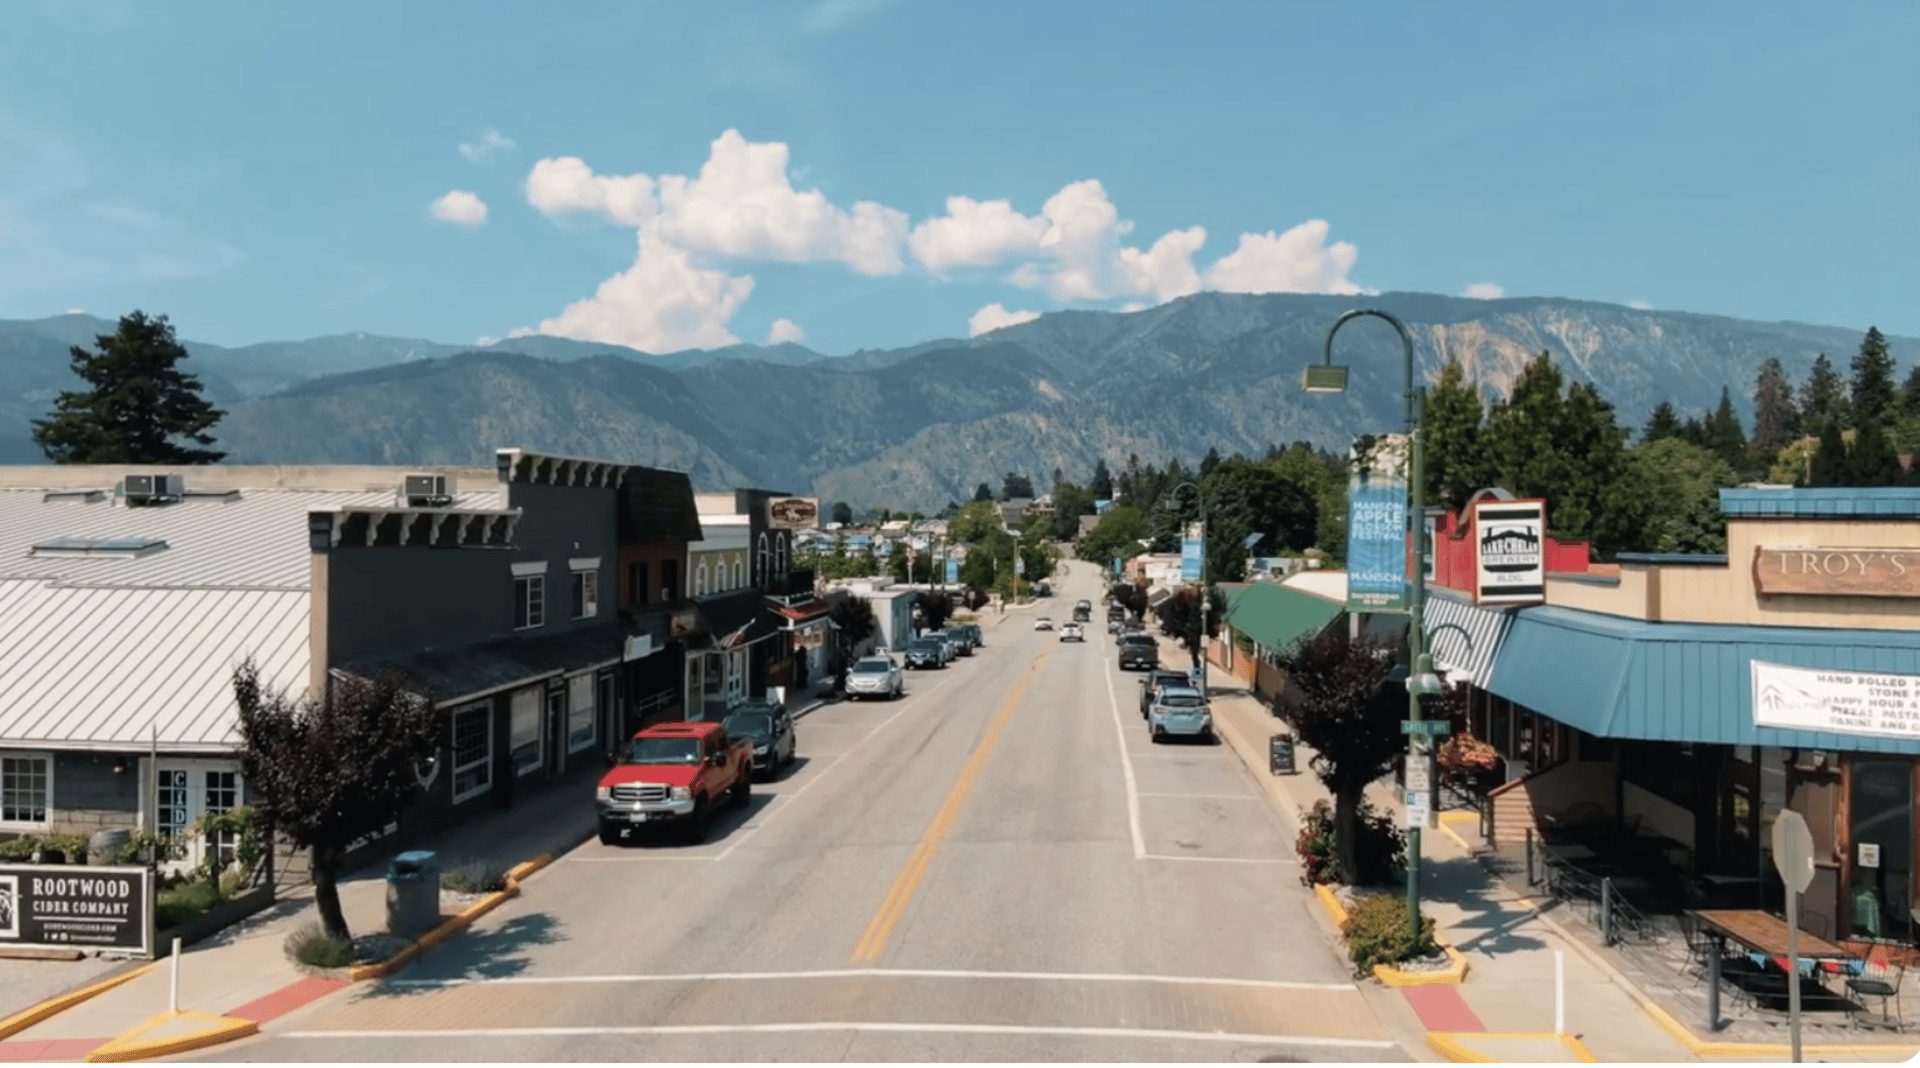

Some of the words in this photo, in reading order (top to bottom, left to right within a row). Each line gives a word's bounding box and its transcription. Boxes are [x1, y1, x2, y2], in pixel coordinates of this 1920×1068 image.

[1353, 501, 1402, 510] MANSON
[1353, 510, 1402, 523] APPLE
[1352, 522, 1402, 531] BLOSSOM
[1352, 531, 1401, 540] FESTIVAL
[1484, 555, 1537, 564] BREWERY
[1777, 552, 1906, 575] TROY'S
[1351, 572, 1402, 583] MANSON
[1817, 674, 1853, 685] HAND
[1868, 688, 1908, 698] STONE
[1868, 699, 1904, 708] HOUR
[1881, 721, 1907, 730] AND
[32, 878, 130, 898] ROOTWOOD
[32, 901, 70, 913] CIDER
[72, 901, 129, 915] COMPANY
